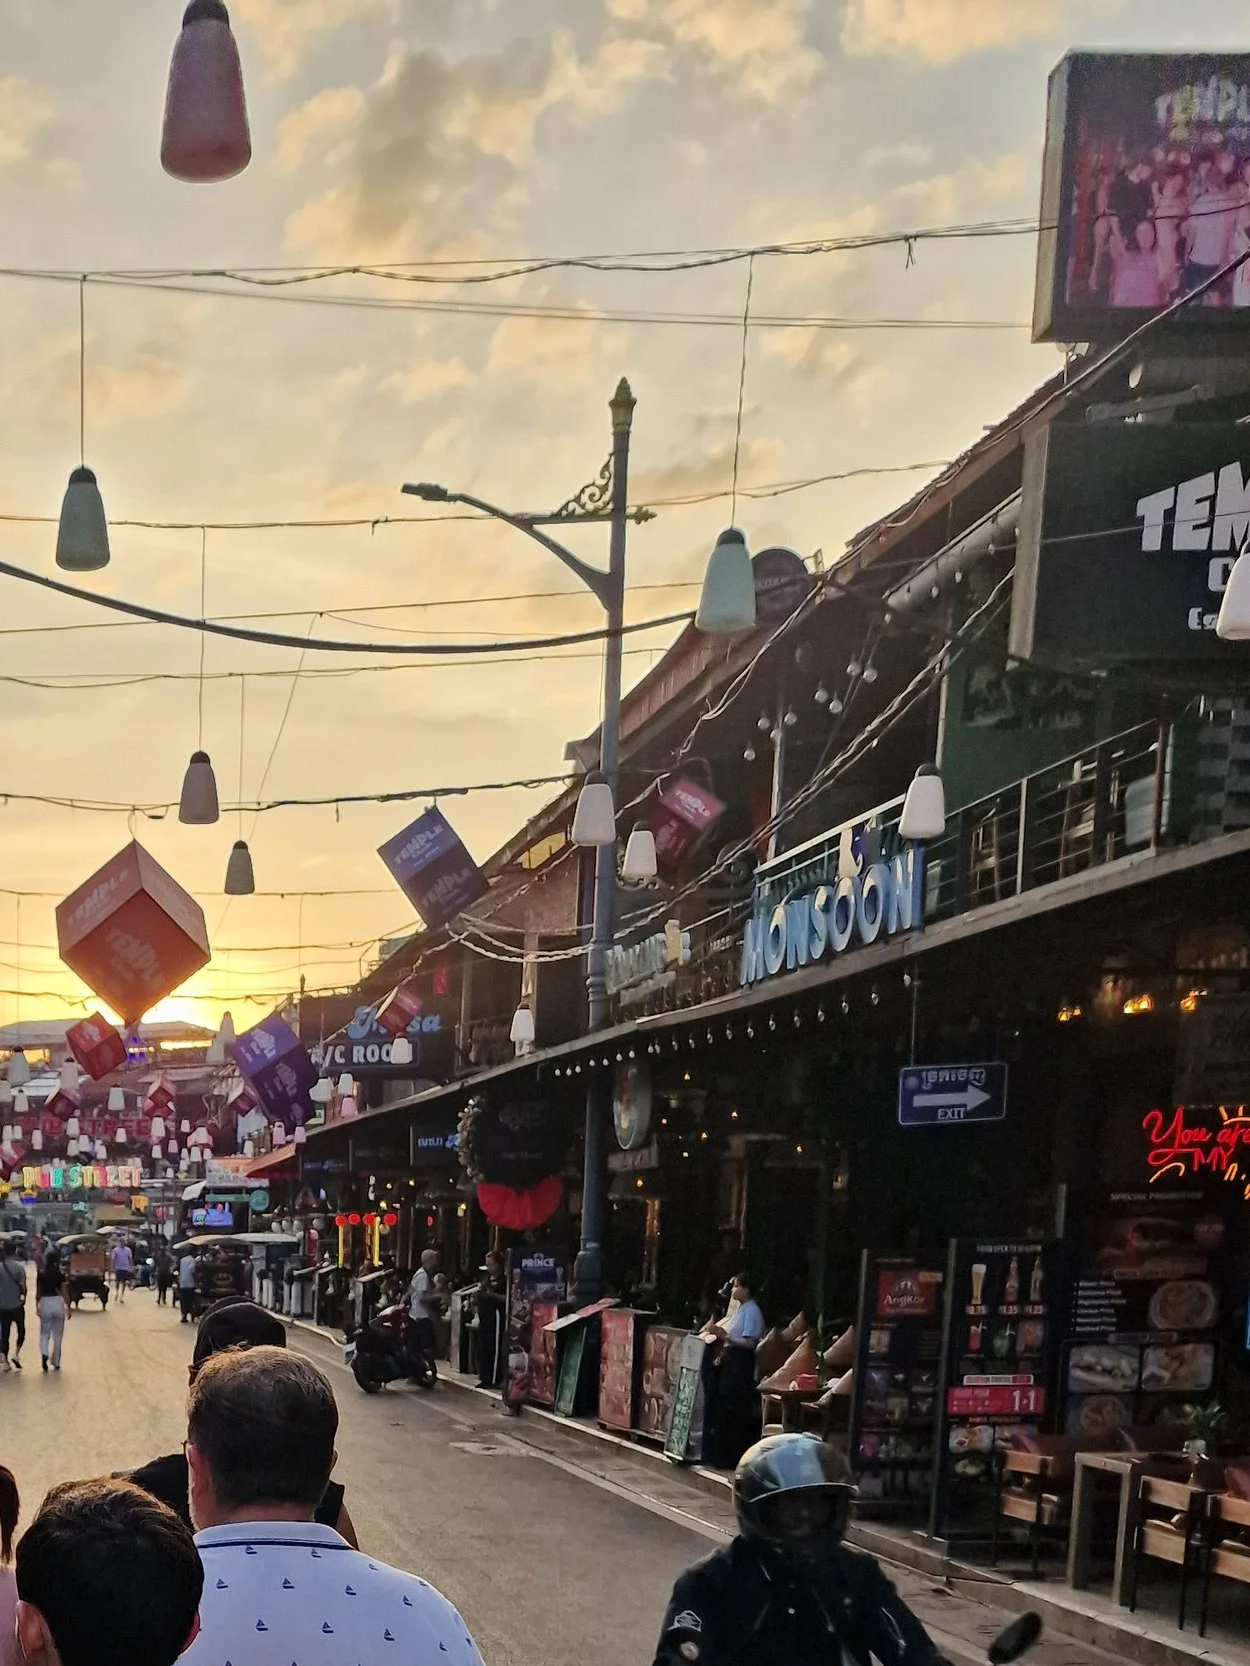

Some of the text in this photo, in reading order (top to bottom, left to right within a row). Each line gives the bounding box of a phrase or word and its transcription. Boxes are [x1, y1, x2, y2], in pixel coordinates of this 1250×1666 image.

[740, 849, 917, 986] MONSOON
[352, 1044, 413, 1064] ROO
[937, 1107, 966, 1120] EXIT
[22, 1163, 142, 1189] PUB STREET
[521, 1257, 555, 1268] PRINCE
[883, 1294, 925, 1308] Angkor
